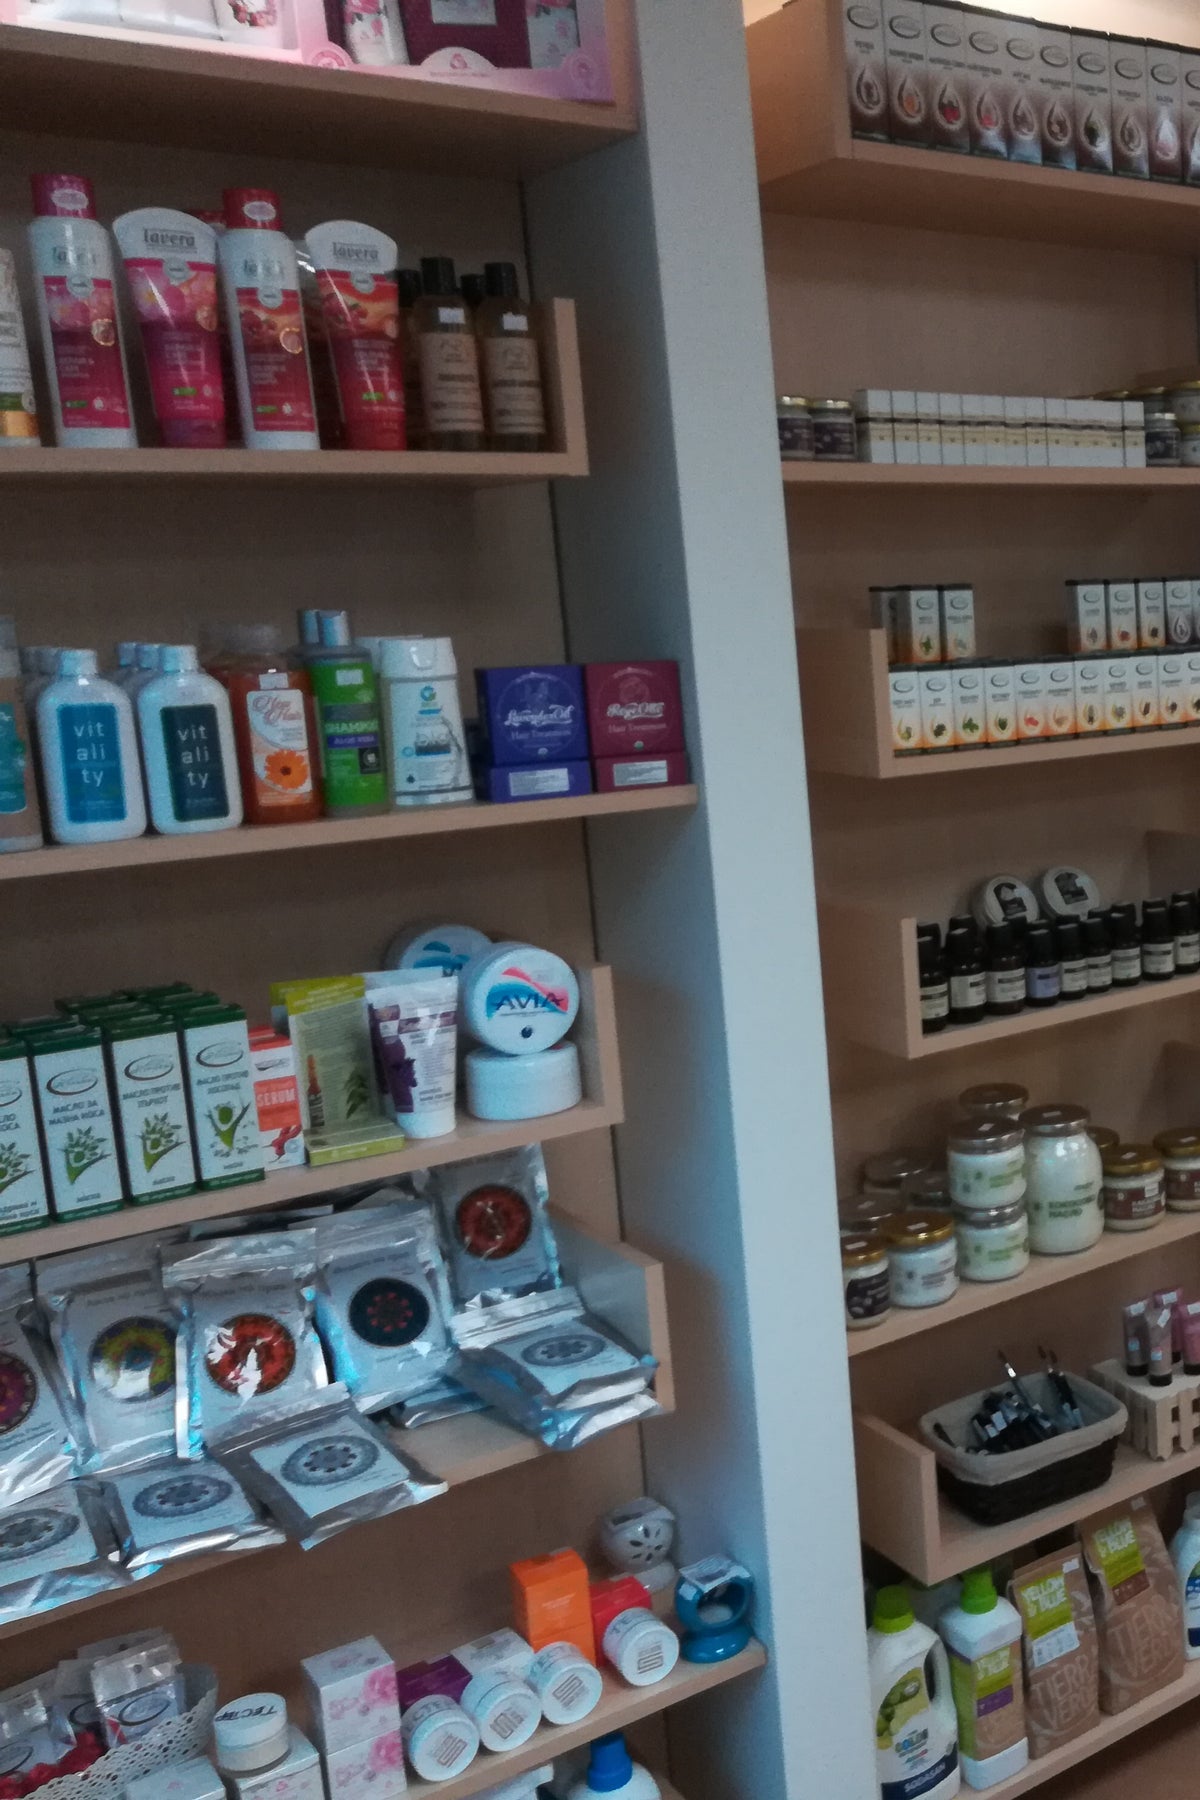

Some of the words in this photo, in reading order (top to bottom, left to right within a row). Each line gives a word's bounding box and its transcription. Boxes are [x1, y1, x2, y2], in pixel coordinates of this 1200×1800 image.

[143, 228, 196, 248] lavera
[332, 242, 379, 261] lavera
[73, 721, 104, 737] vit
[176, 724, 208, 741] vit
[77, 743, 106, 761] ali
[180, 746, 209, 764] ali
[82, 769, 104, 787] ty
[186, 771, 209, 788] ty
[495, 993, 564, 1011] AVIA
[257, 1087, 296, 1107] SERUM
